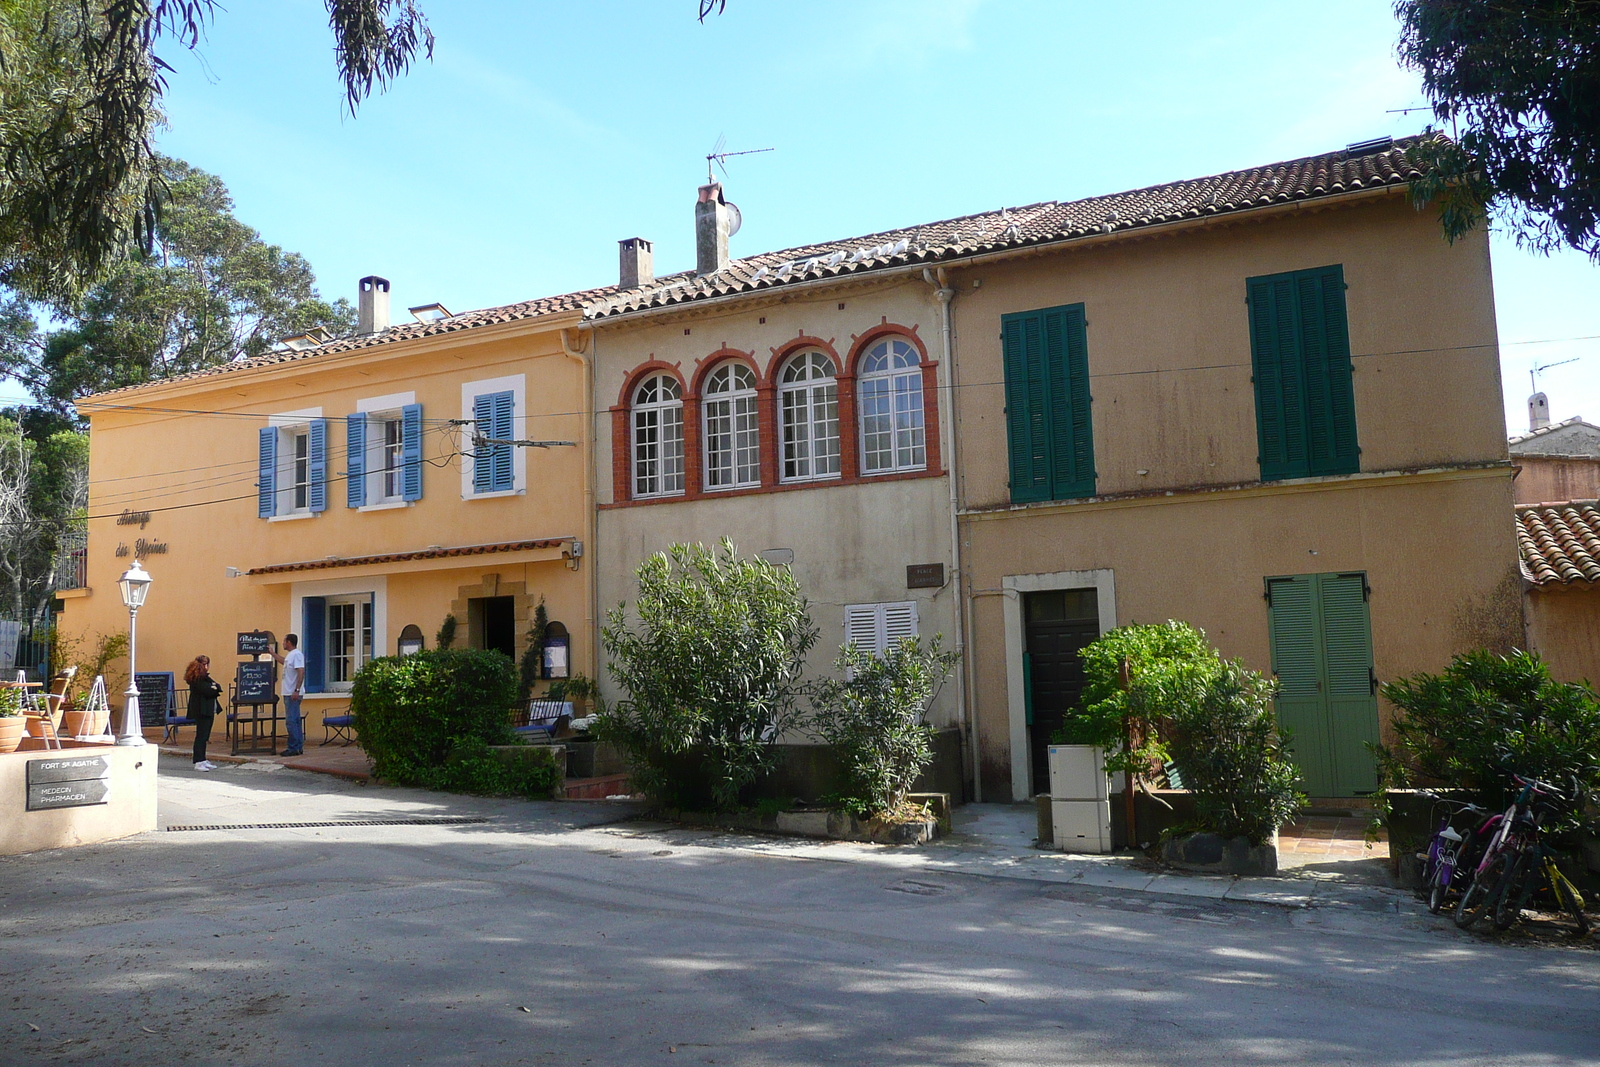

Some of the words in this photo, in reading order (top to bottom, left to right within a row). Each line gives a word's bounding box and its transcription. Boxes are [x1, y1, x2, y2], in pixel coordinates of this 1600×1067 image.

[116, 508, 150, 530] Auberge
[115, 542, 128, 558] des
[134, 538, 167, 561] Glycines
[40, 762, 60, 770] FORT
[71, 759, 100, 768] AGATHE
[40, 793, 86, 803] PHARMACIEN
